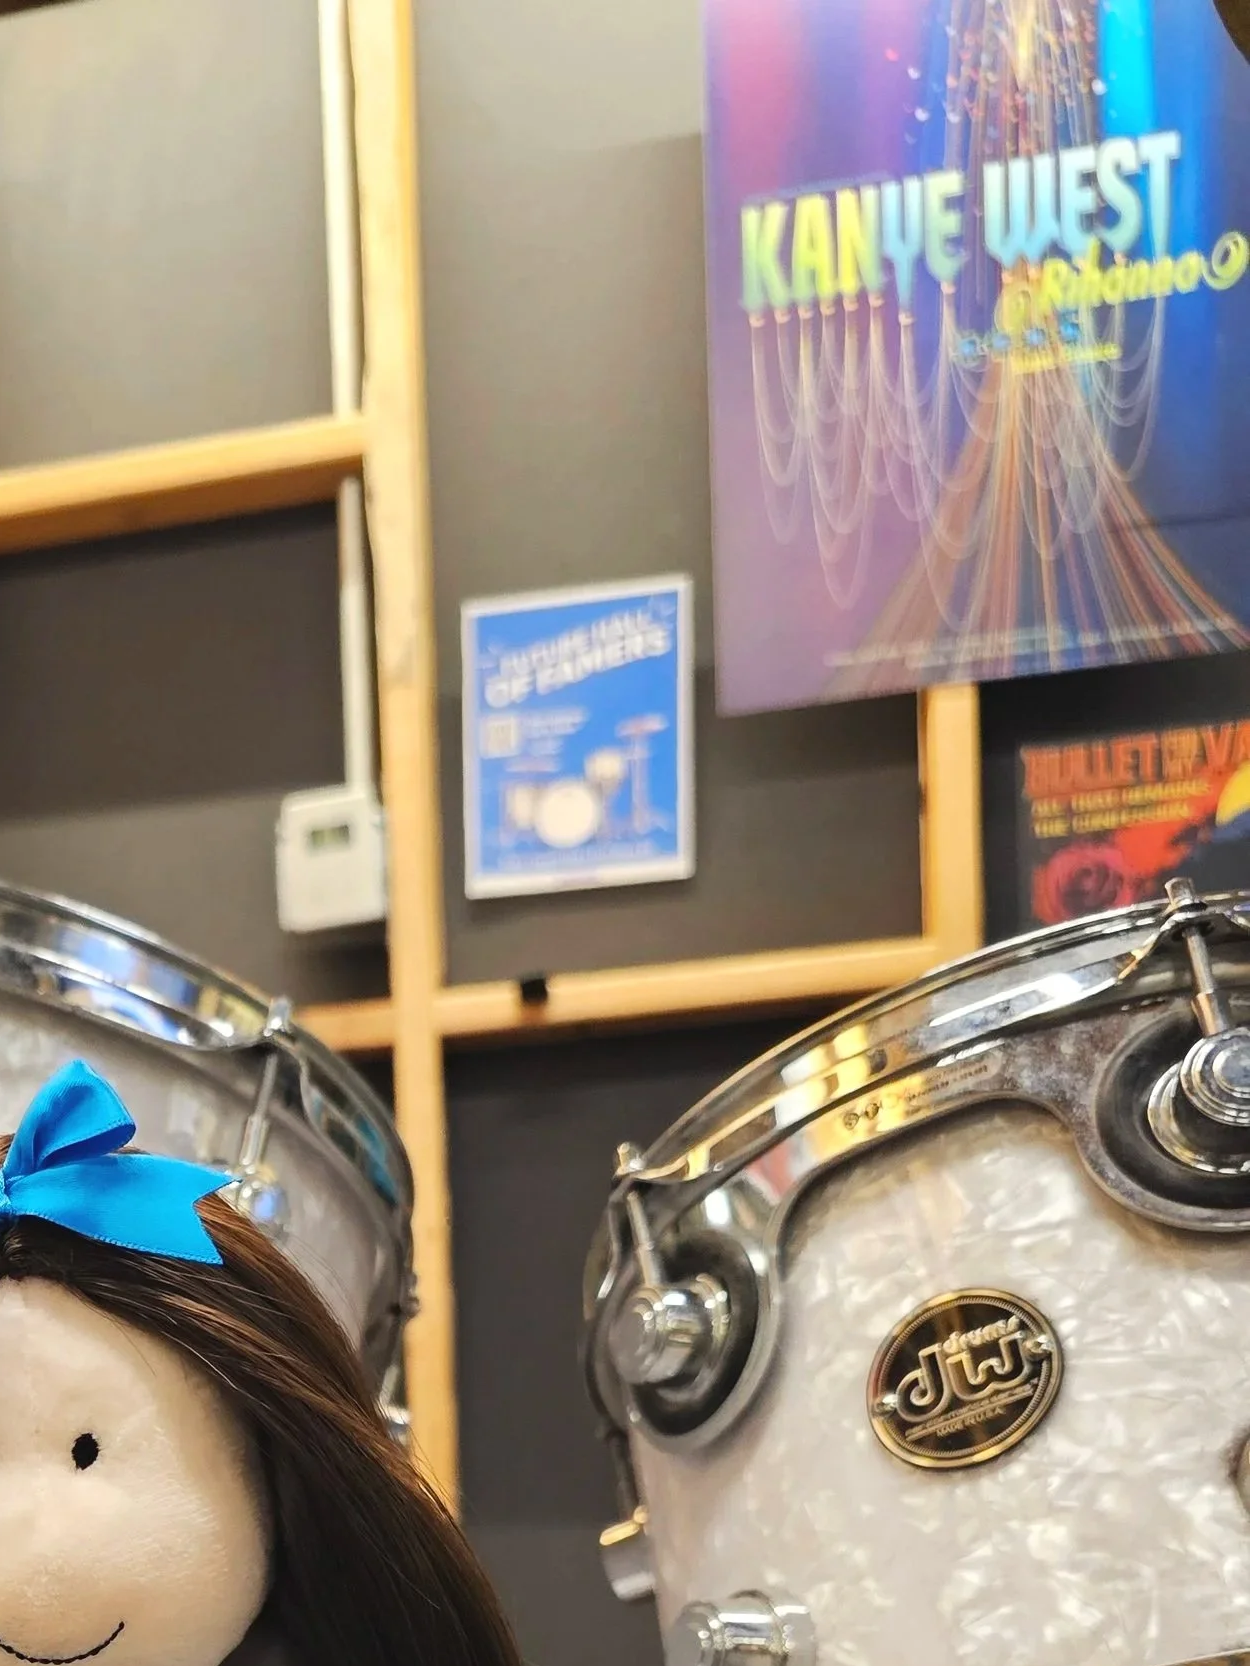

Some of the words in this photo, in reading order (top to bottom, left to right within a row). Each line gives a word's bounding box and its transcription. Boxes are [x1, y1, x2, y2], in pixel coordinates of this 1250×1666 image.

[739, 169, 965, 313] KANYE
[982, 130, 1180, 269] WEST
[1020, 733, 1158, 799] BULLET
[942, 1314, 1022, 1354] drums
